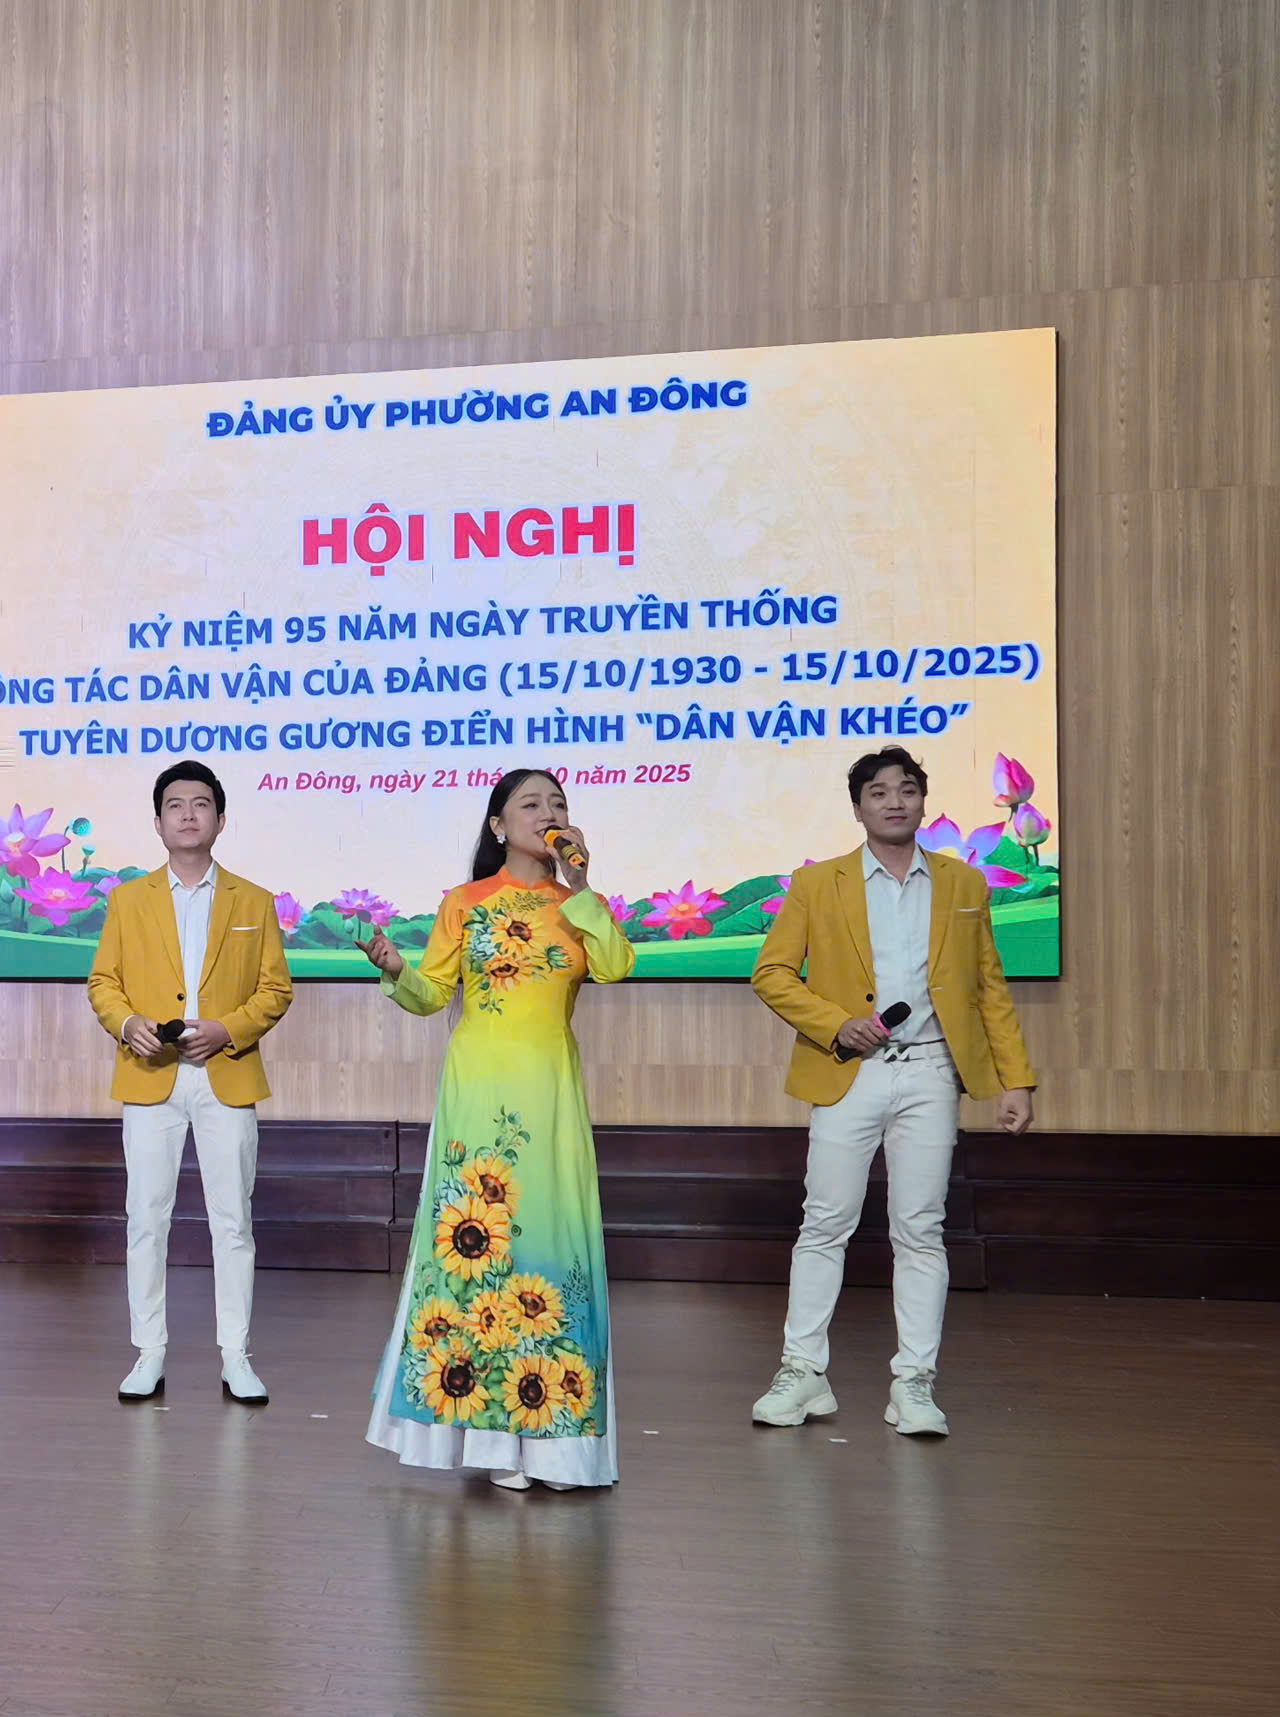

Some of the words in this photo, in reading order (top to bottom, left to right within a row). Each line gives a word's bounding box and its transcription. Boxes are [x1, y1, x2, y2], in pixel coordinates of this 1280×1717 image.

[206, 400, 313, 438] ĐẢNG
[324, 394, 376, 431] ỦY
[385, 389, 550, 428] PHƯỜNG
[559, 388, 617, 418] AN
[627, 376, 747, 414] ĐÔNG
[303, 503, 425, 577] HỘI
[454, 504, 635, 567] NGHỊ
[129, 613, 173, 649] KỶ
[183, 610, 273, 653] NIỆM
[284, 615, 327, 644] 95
[338, 604, 417, 642] NĂM
[429, 599, 530, 639] NGÀY
[539, 593, 689, 635] TRUYỀN
[699, 587, 837, 629] THỐNG
[64, 667, 129, 703] TÁC
[140, 665, 210, 701] DÂN
[220, 662, 291, 705] VẬN
[302, 659, 375, 697] CỦA
[383, 656, 487, 694] ĐẢNG
[499, 655, 742, 698] (15/10/1930
[782, 643, 1040, 686] 15/10/2025)
[18, 719, 128, 756] TUYÊN
[141, 721, 268, 753] DƯƠNG
[279, 717, 411, 751] GƯƠNG
[421, 708, 514, 747] ĐIỂN
[527, 706, 624, 744] HÌNH
[746, 700, 826, 745] VẬN
[258, 773, 288, 791] An
[295, 772, 362, 793] Đông,
[370, 770, 426, 793] ngày
[431, 770, 458, 787] 21
[467, 767, 503, 787] thá
[575, 765, 627, 785] năm
[633, 764, 692, 783] 2025
